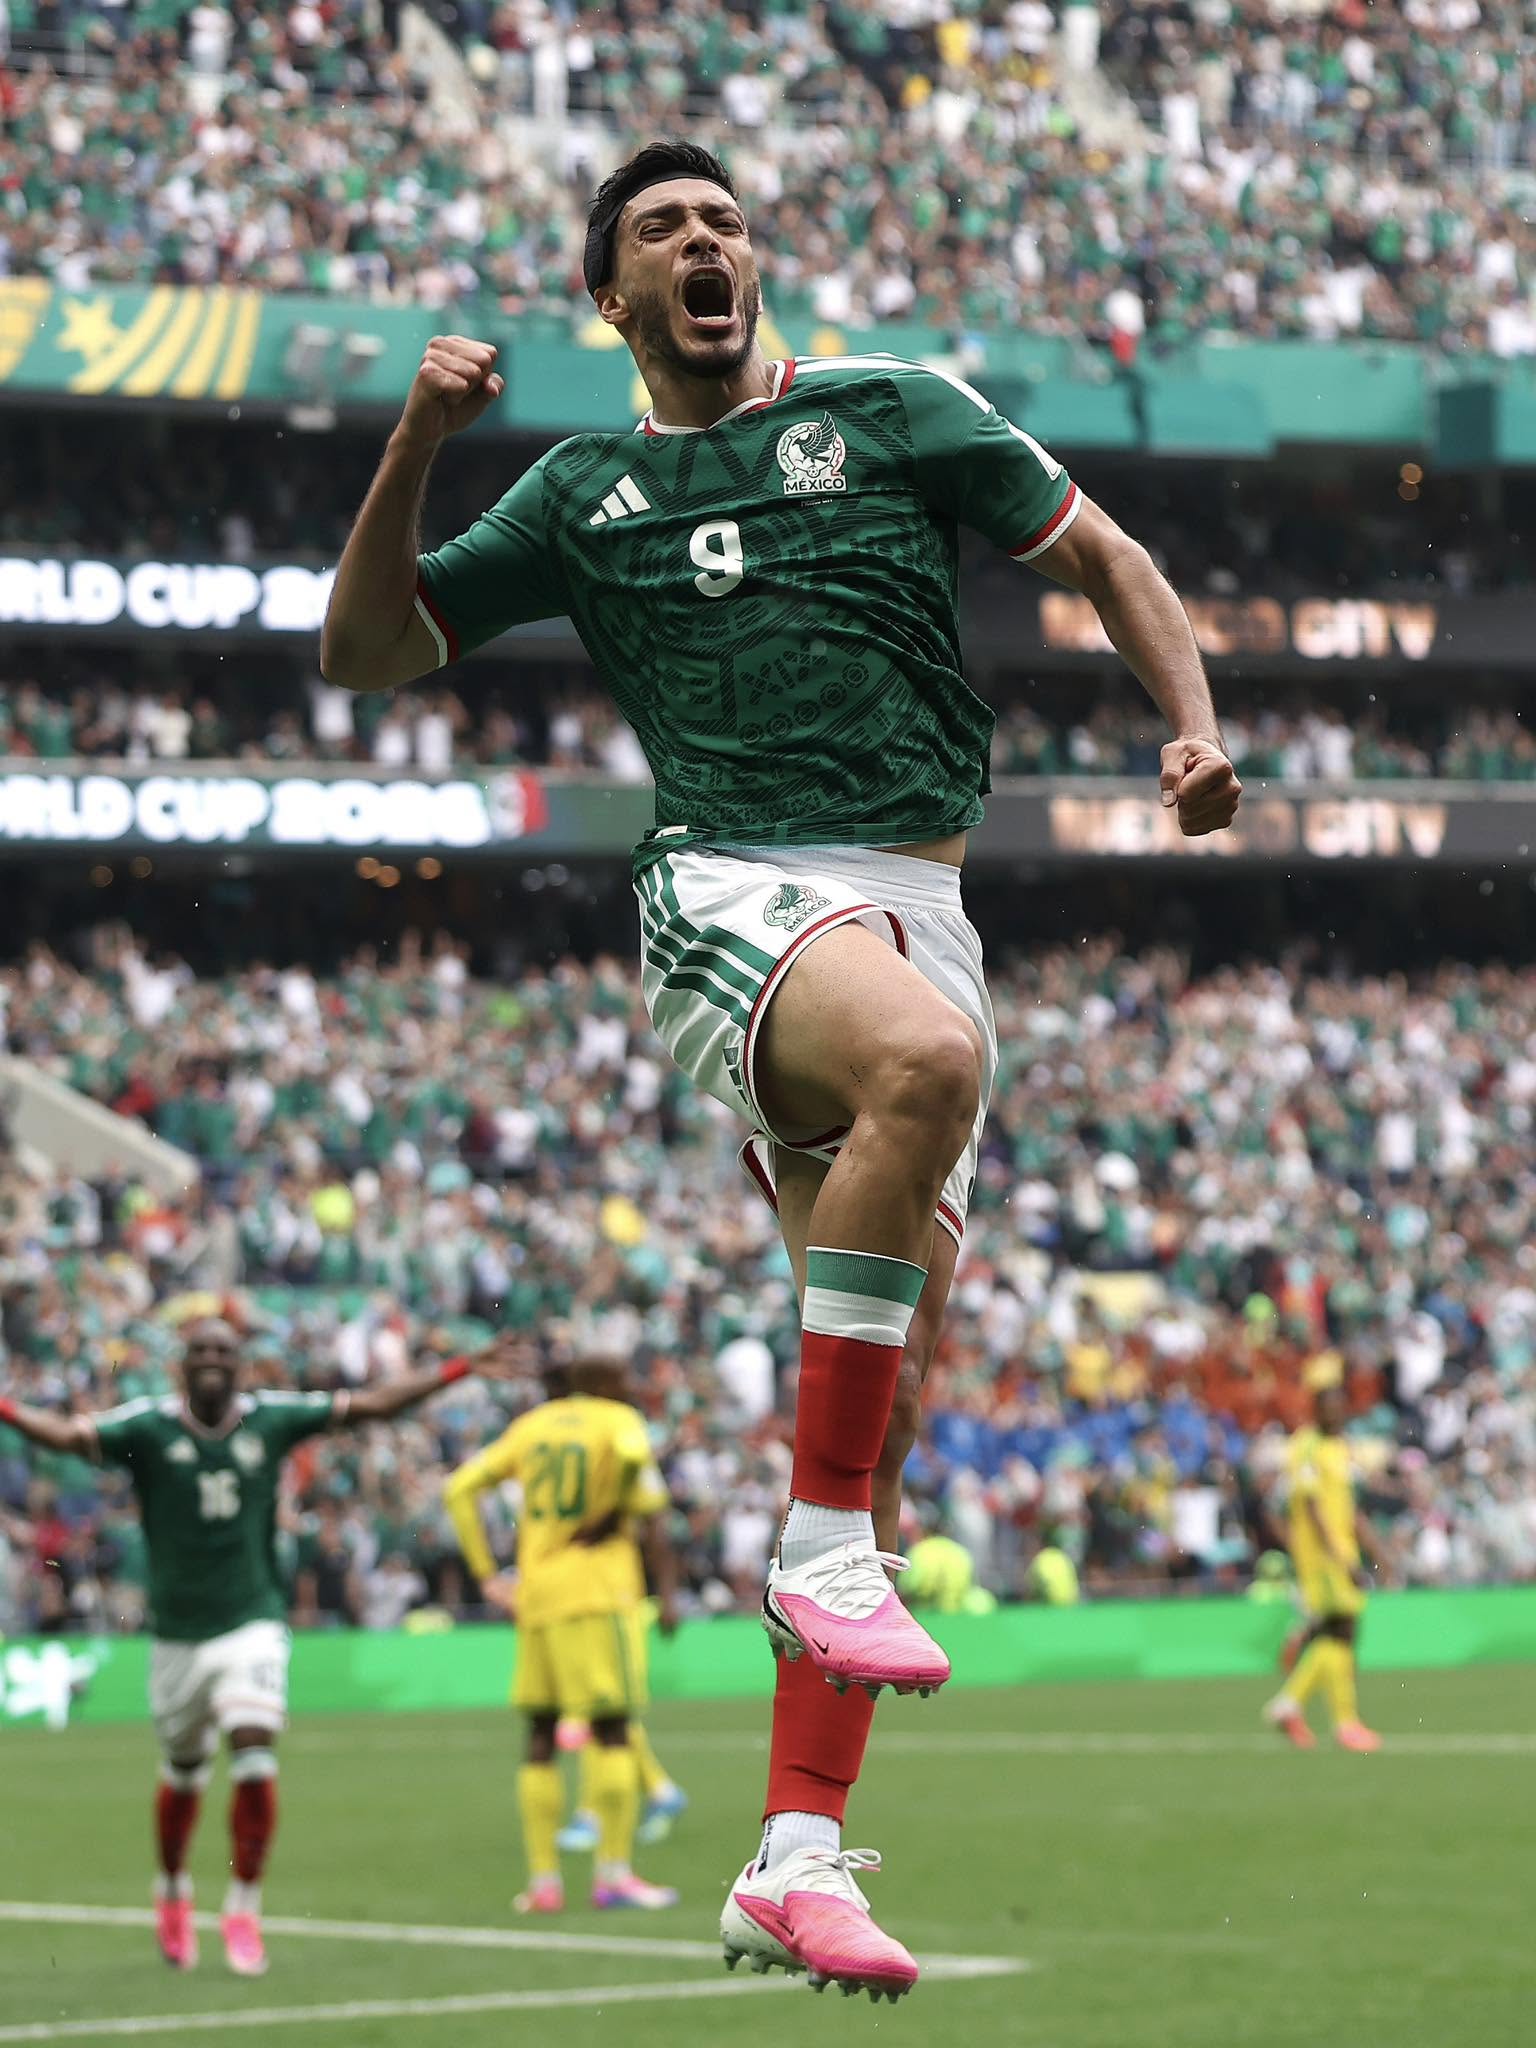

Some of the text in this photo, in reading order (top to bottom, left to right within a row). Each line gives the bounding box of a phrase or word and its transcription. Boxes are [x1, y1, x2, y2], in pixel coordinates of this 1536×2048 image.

[785, 478, 844, 492] MÉXICO
[689, 519, 744, 597] 9
[127, 562, 260, 629] CUP
[135, 776, 268, 842] CUP
[525, 1440, 586, 1519] 20
